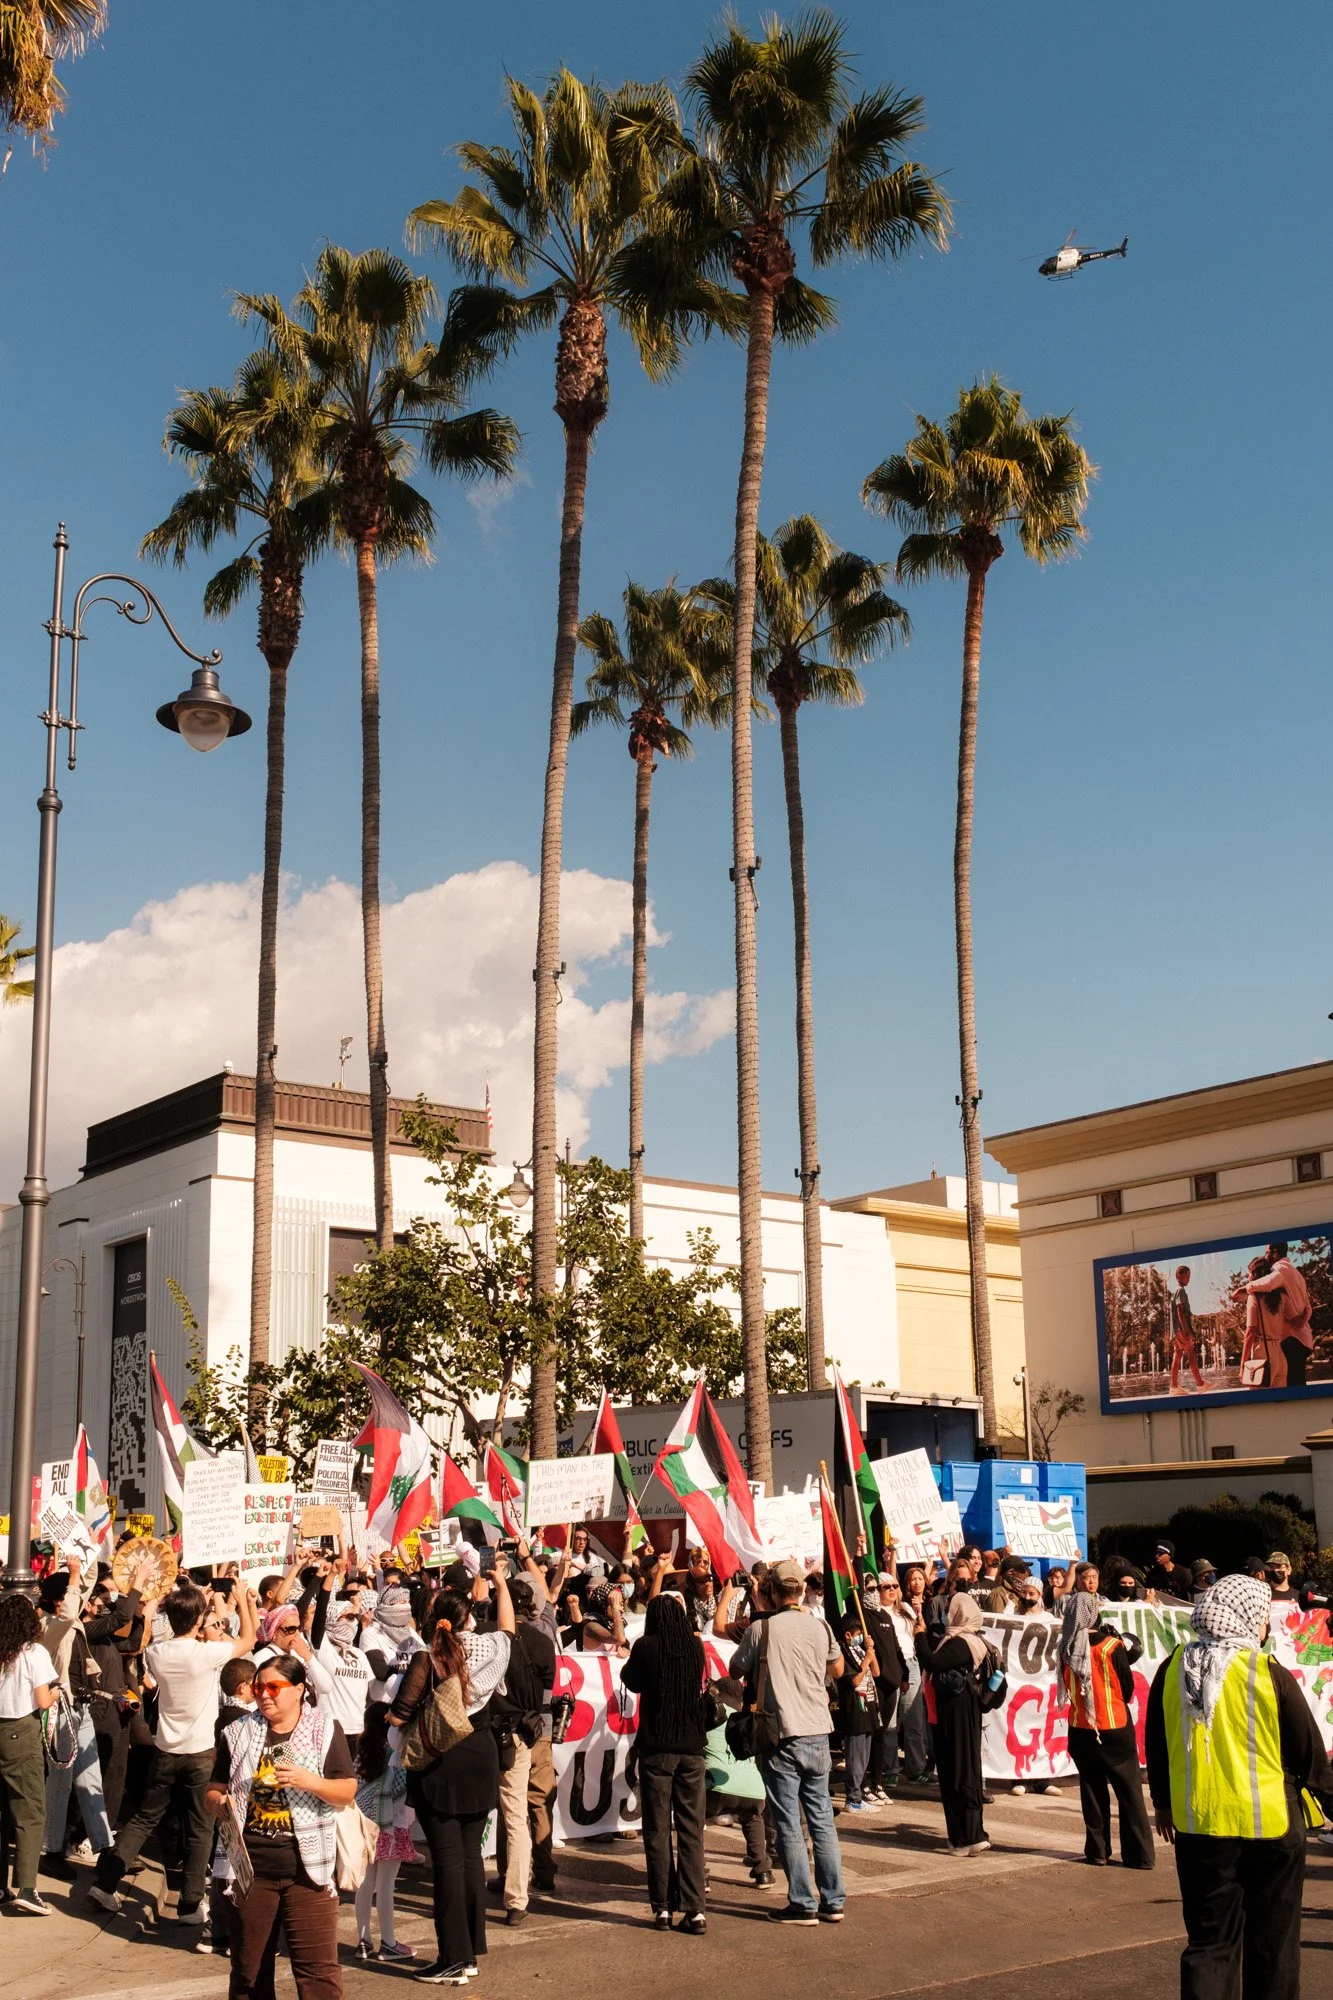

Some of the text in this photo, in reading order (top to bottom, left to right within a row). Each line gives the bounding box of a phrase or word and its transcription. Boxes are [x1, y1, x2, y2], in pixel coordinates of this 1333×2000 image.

[319, 1443, 354, 1457] FREE ALL
[51, 1462, 70, 1480] END
[259, 1458, 287, 1471] PALESTINE
[531, 1464, 555, 1478] THIS
[275, 1471, 285, 1484] BE
[52, 1480, 68, 1497] ALL
[244, 1494, 293, 1511] RESPECT
[41, 1506, 62, 1532] FREE
[244, 1511, 293, 1525] EXISTENCE
[1000, 1505, 1041, 1528] FREE
[53, 1510, 79, 1546] PALESTINE
[244, 1540, 281, 1555] EXPECT
[1006, 1531, 1076, 1558] PALESTINE
